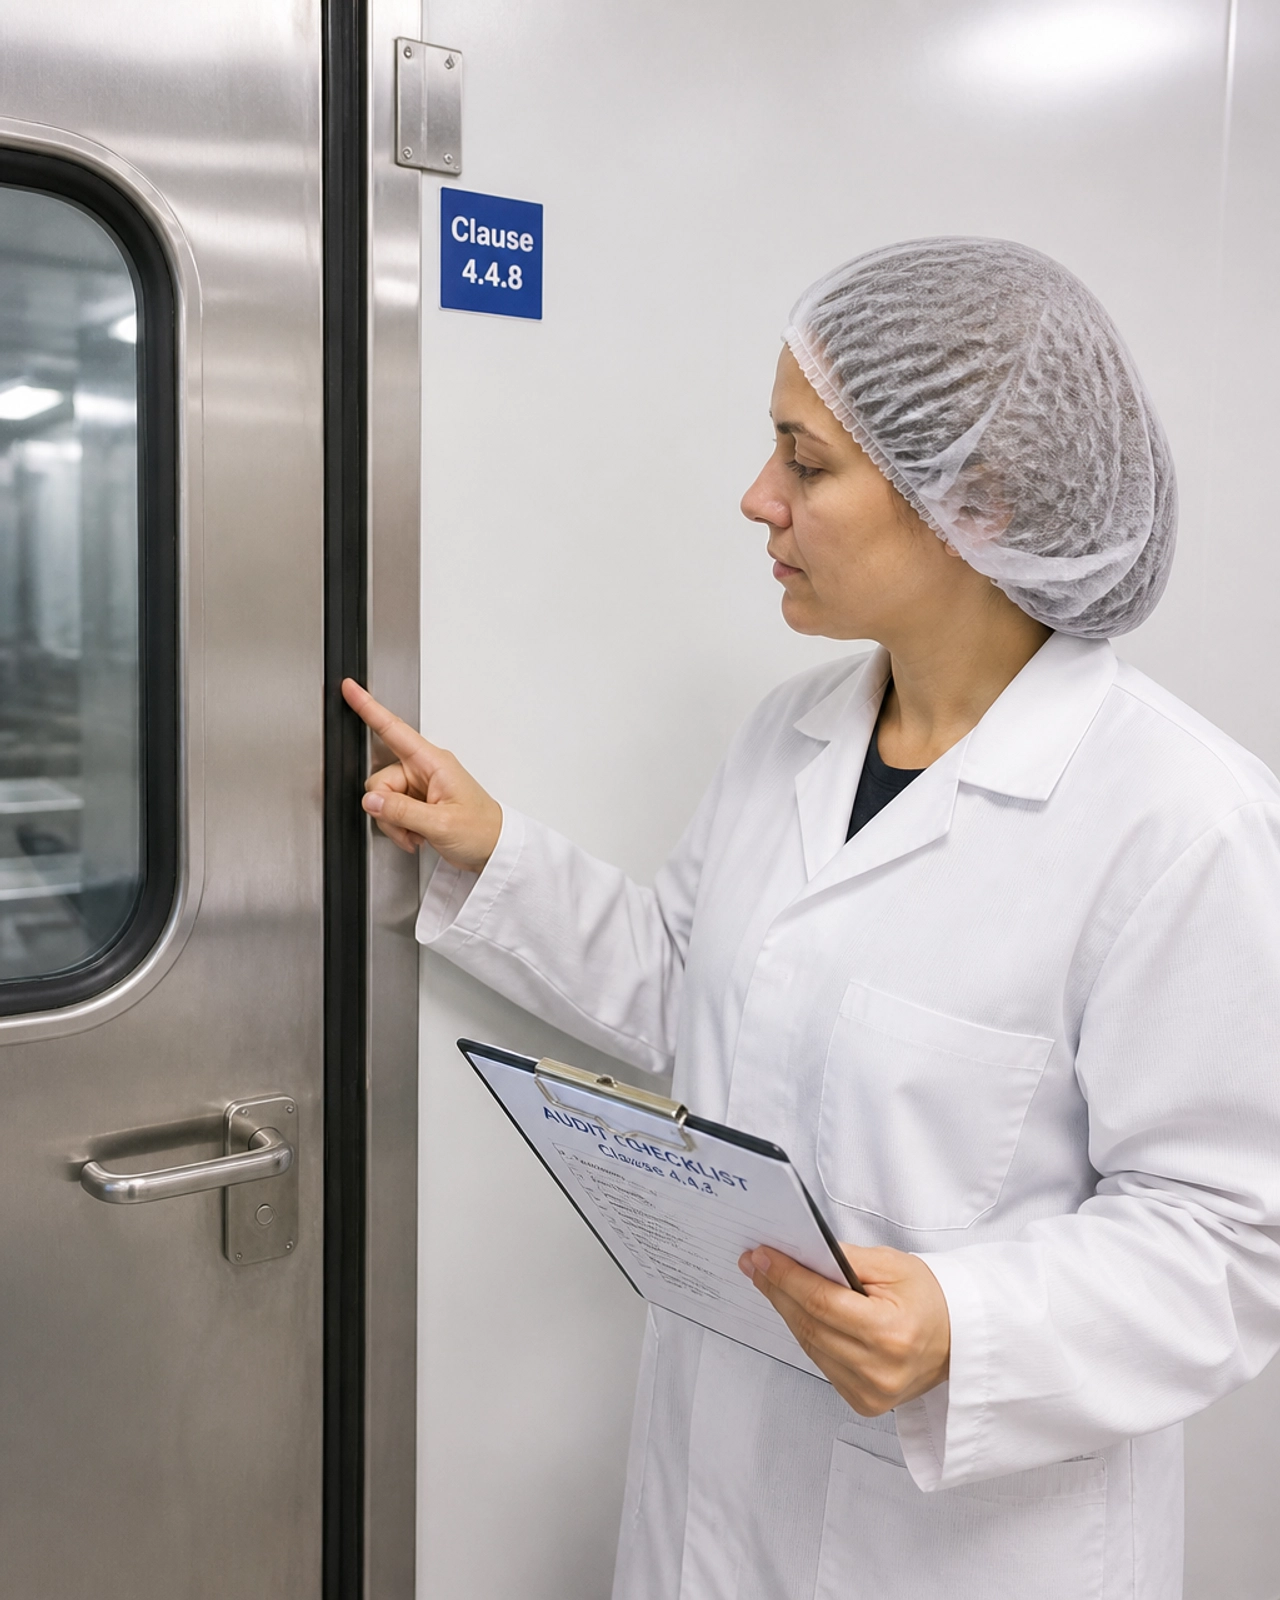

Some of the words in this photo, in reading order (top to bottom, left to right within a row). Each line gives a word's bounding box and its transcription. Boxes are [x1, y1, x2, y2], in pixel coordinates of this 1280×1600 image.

[451, 215, 534, 253] Clause
[461, 258, 523, 290] 4.4.8
[542, 1106, 607, 1141] AUDIT
